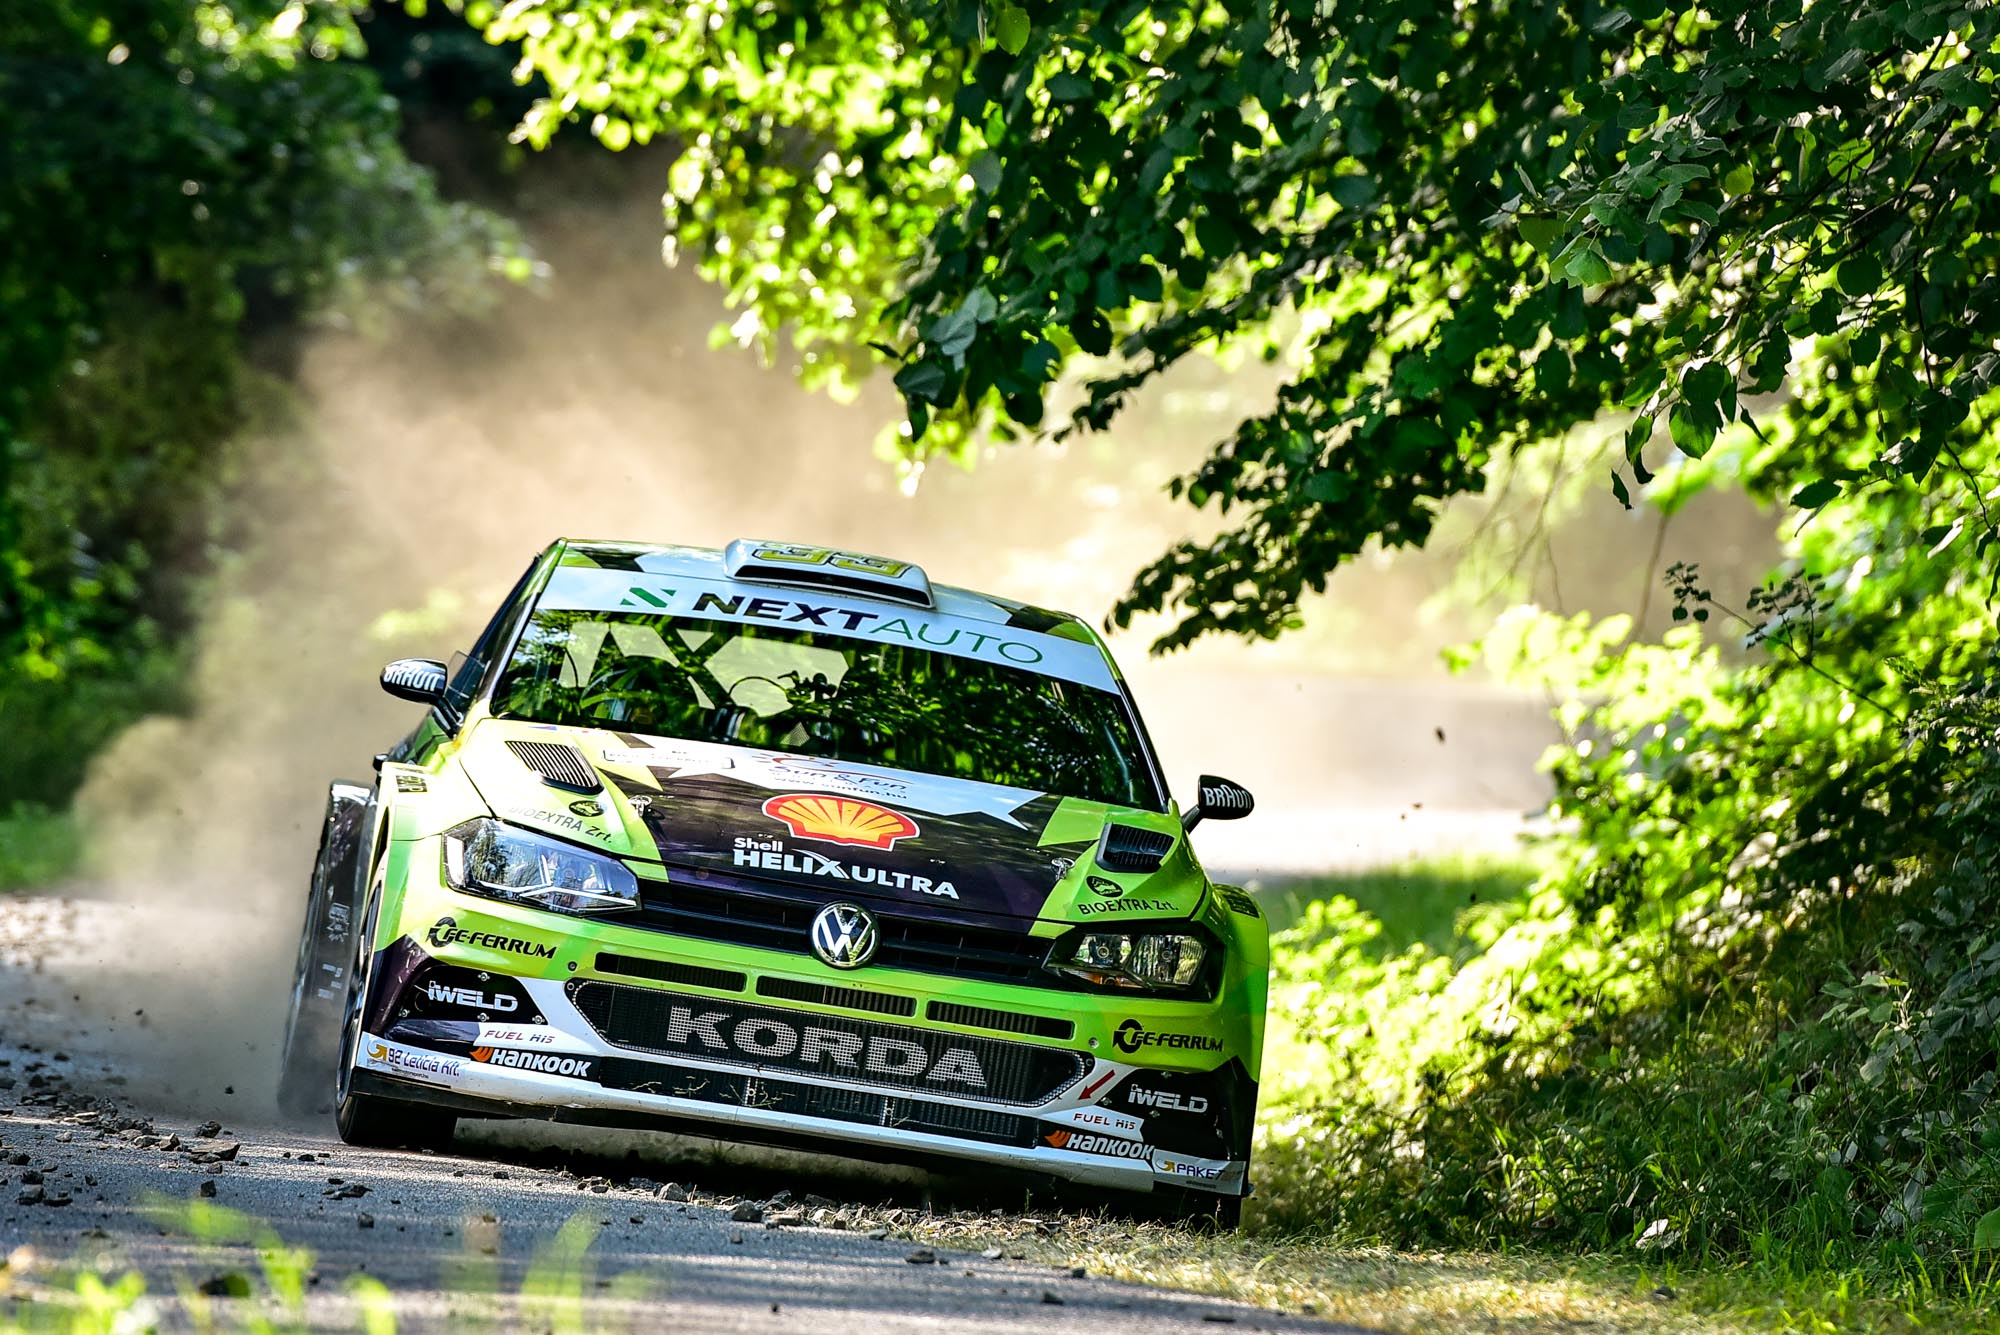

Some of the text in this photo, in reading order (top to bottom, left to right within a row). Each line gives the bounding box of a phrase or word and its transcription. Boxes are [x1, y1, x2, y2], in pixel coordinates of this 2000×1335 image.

[1202, 784, 1252, 809] BRAUN
[585, 826, 612, 843] Zrt.
[734, 838, 783, 852] Shell
[733, 849, 960, 900] HELIX ULTRA
[1078, 898, 1179, 915] BIOEXTRA Zrt.
[485, 1029, 524, 1041] FUEL
[666, 1005, 988, 1088] KORDA
[388, 1048, 403, 1065] 92
[1073, 1113, 1110, 1126] FUEL
